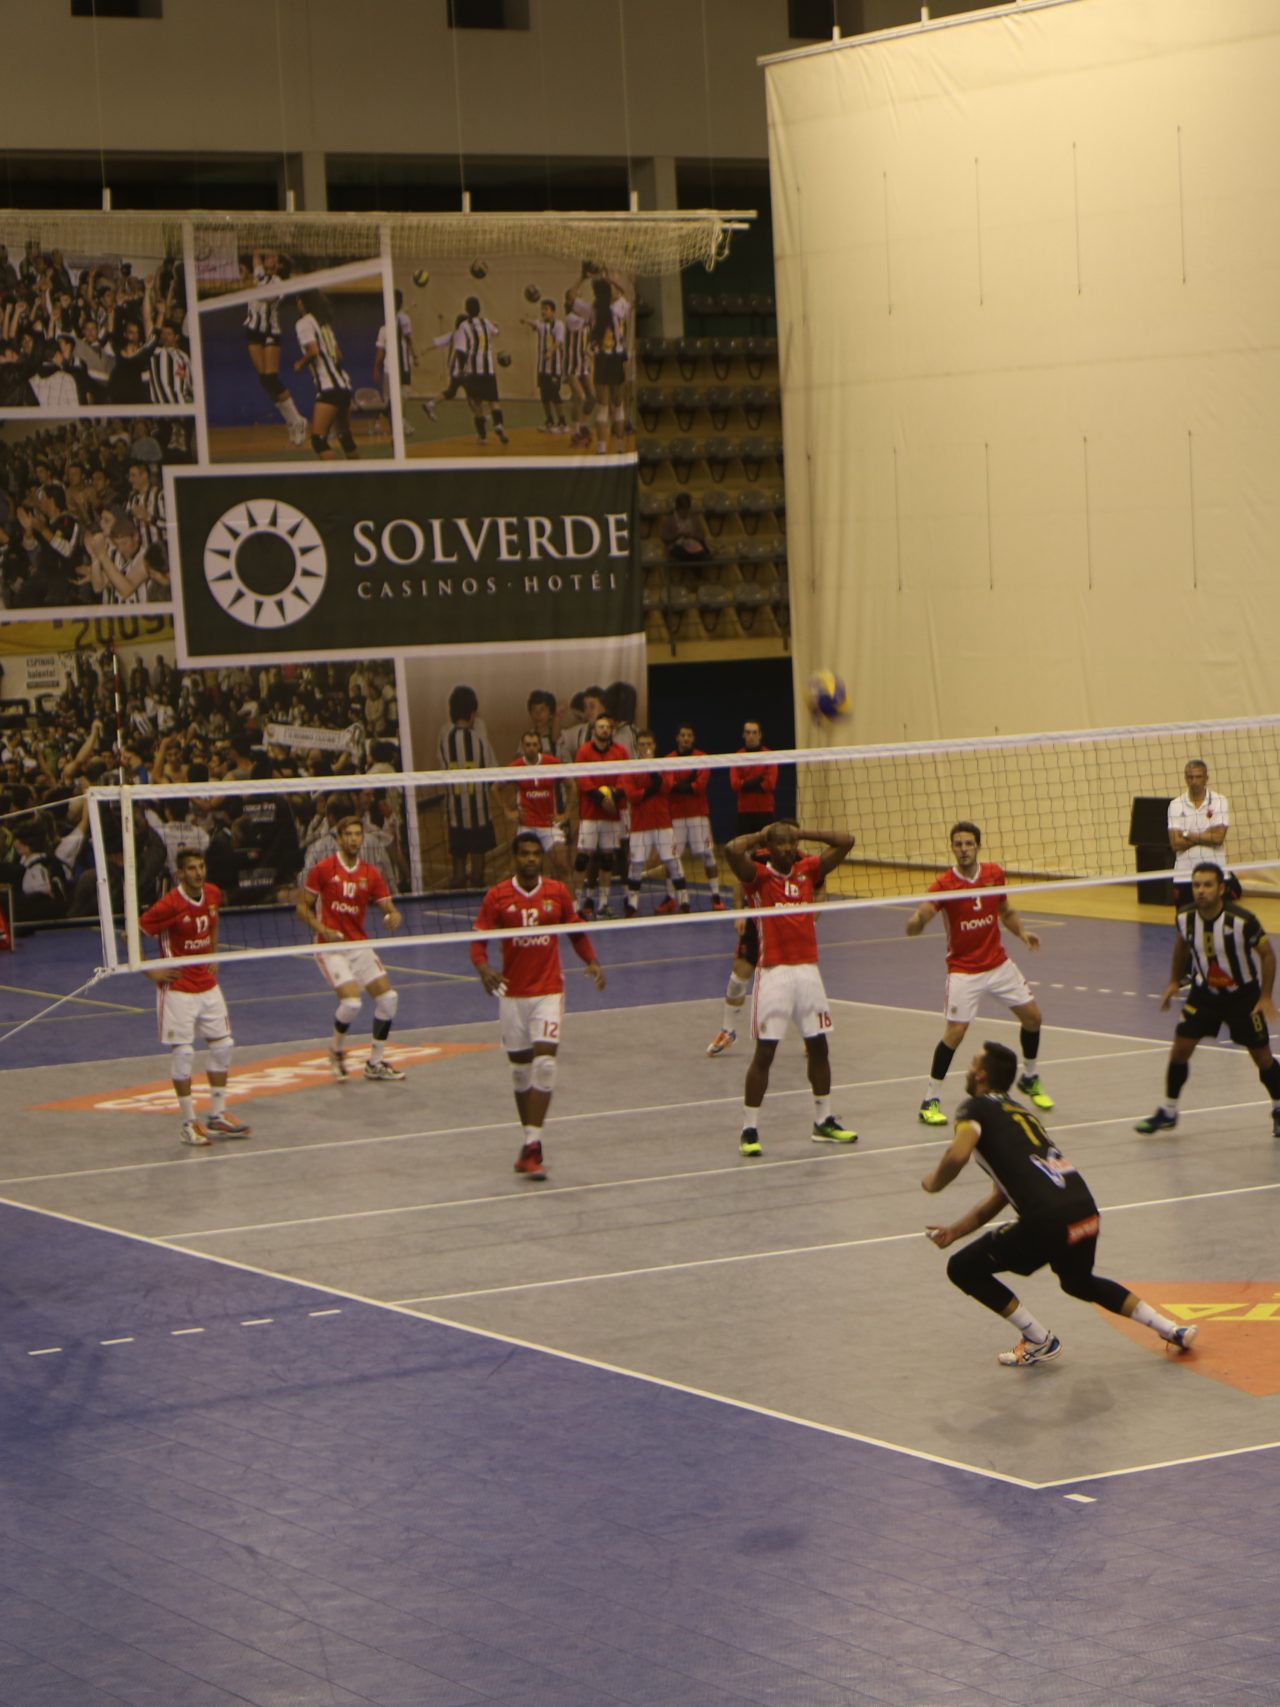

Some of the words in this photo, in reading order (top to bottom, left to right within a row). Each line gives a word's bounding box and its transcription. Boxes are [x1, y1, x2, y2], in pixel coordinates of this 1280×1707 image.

[353, 513, 630, 566] SOLVERDE
[357, 577, 497, 599] CASINOS
[524, 570, 628, 593] HOTÉI
[342, 881, 356, 898] 10
[521, 908, 539, 927] 12
[960, 914, 994, 931] nowo
[512, 935, 550, 947] nowo
[817, 1011, 832, 1029] 16
[1252, 1014, 1264, 1032] 8
[543, 1020, 559, 1039] 12
